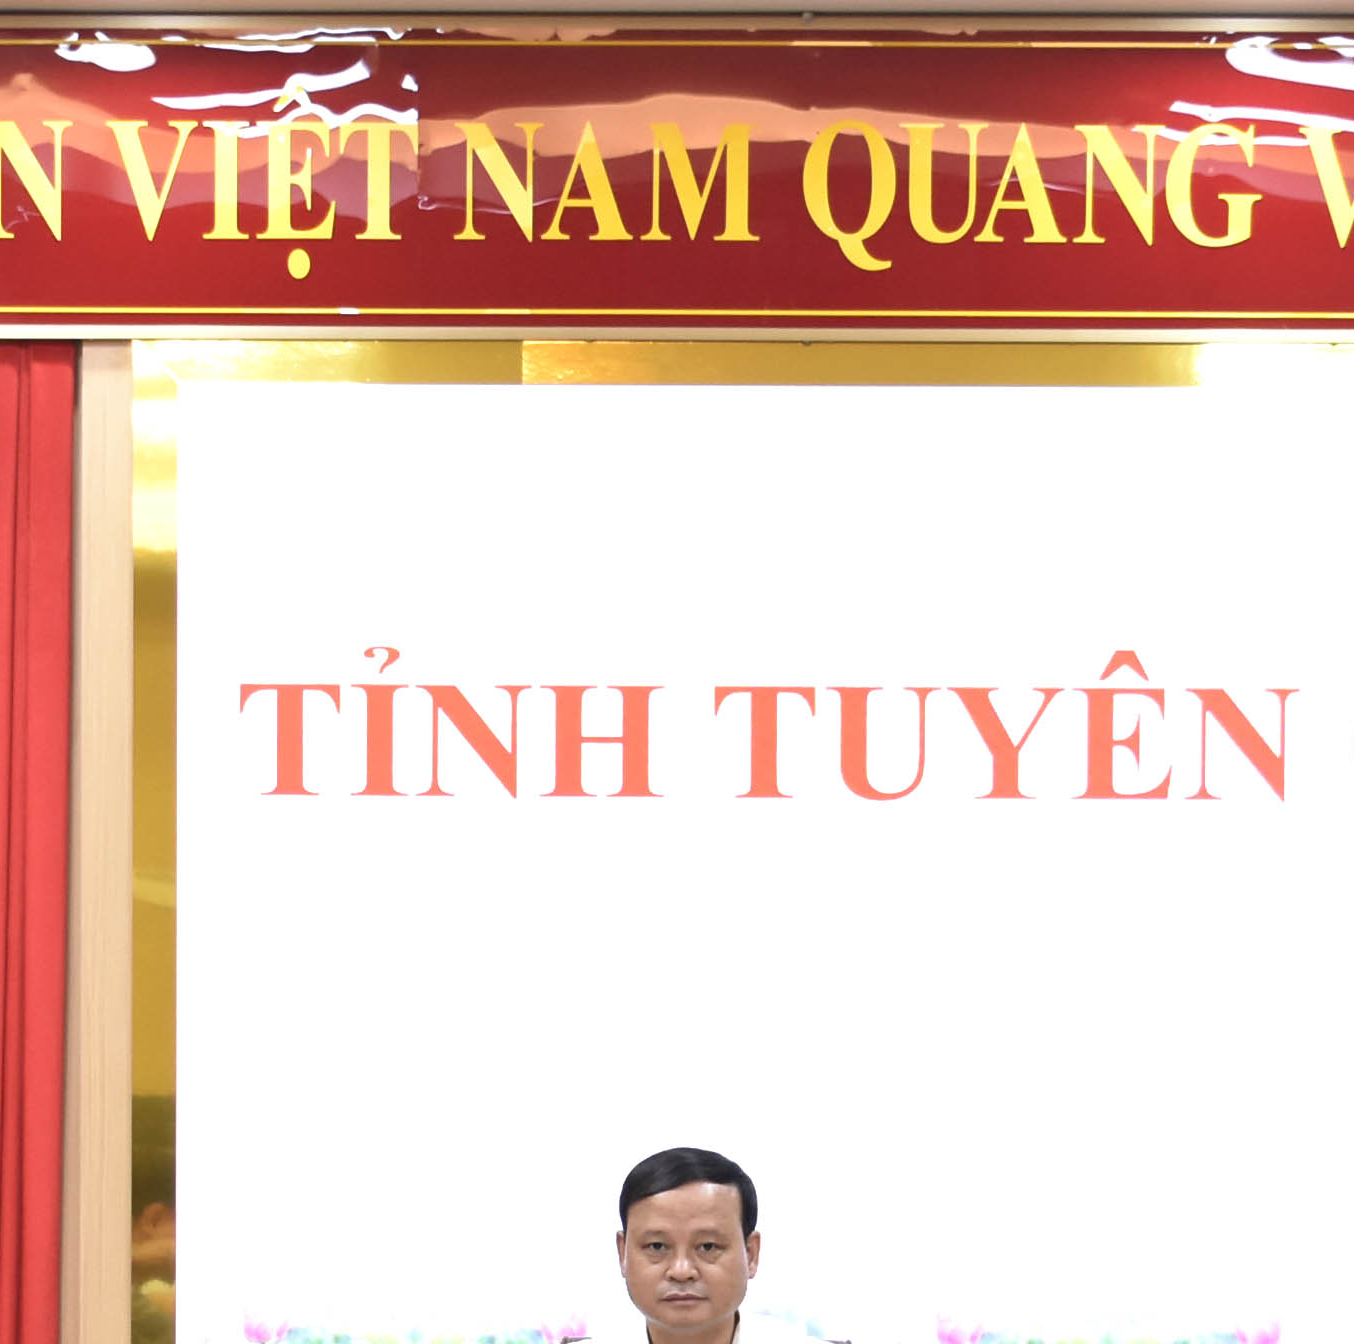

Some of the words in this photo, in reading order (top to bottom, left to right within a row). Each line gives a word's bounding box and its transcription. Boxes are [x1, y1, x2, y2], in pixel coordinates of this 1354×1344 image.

[105, 86, 419, 280] VIỆT
[453, 120, 760, 243] NAM
[802, 119, 1257, 271] QUANG
[238, 646, 665, 799] TỈNH
[713, 649, 1301, 802] TUYÊN
